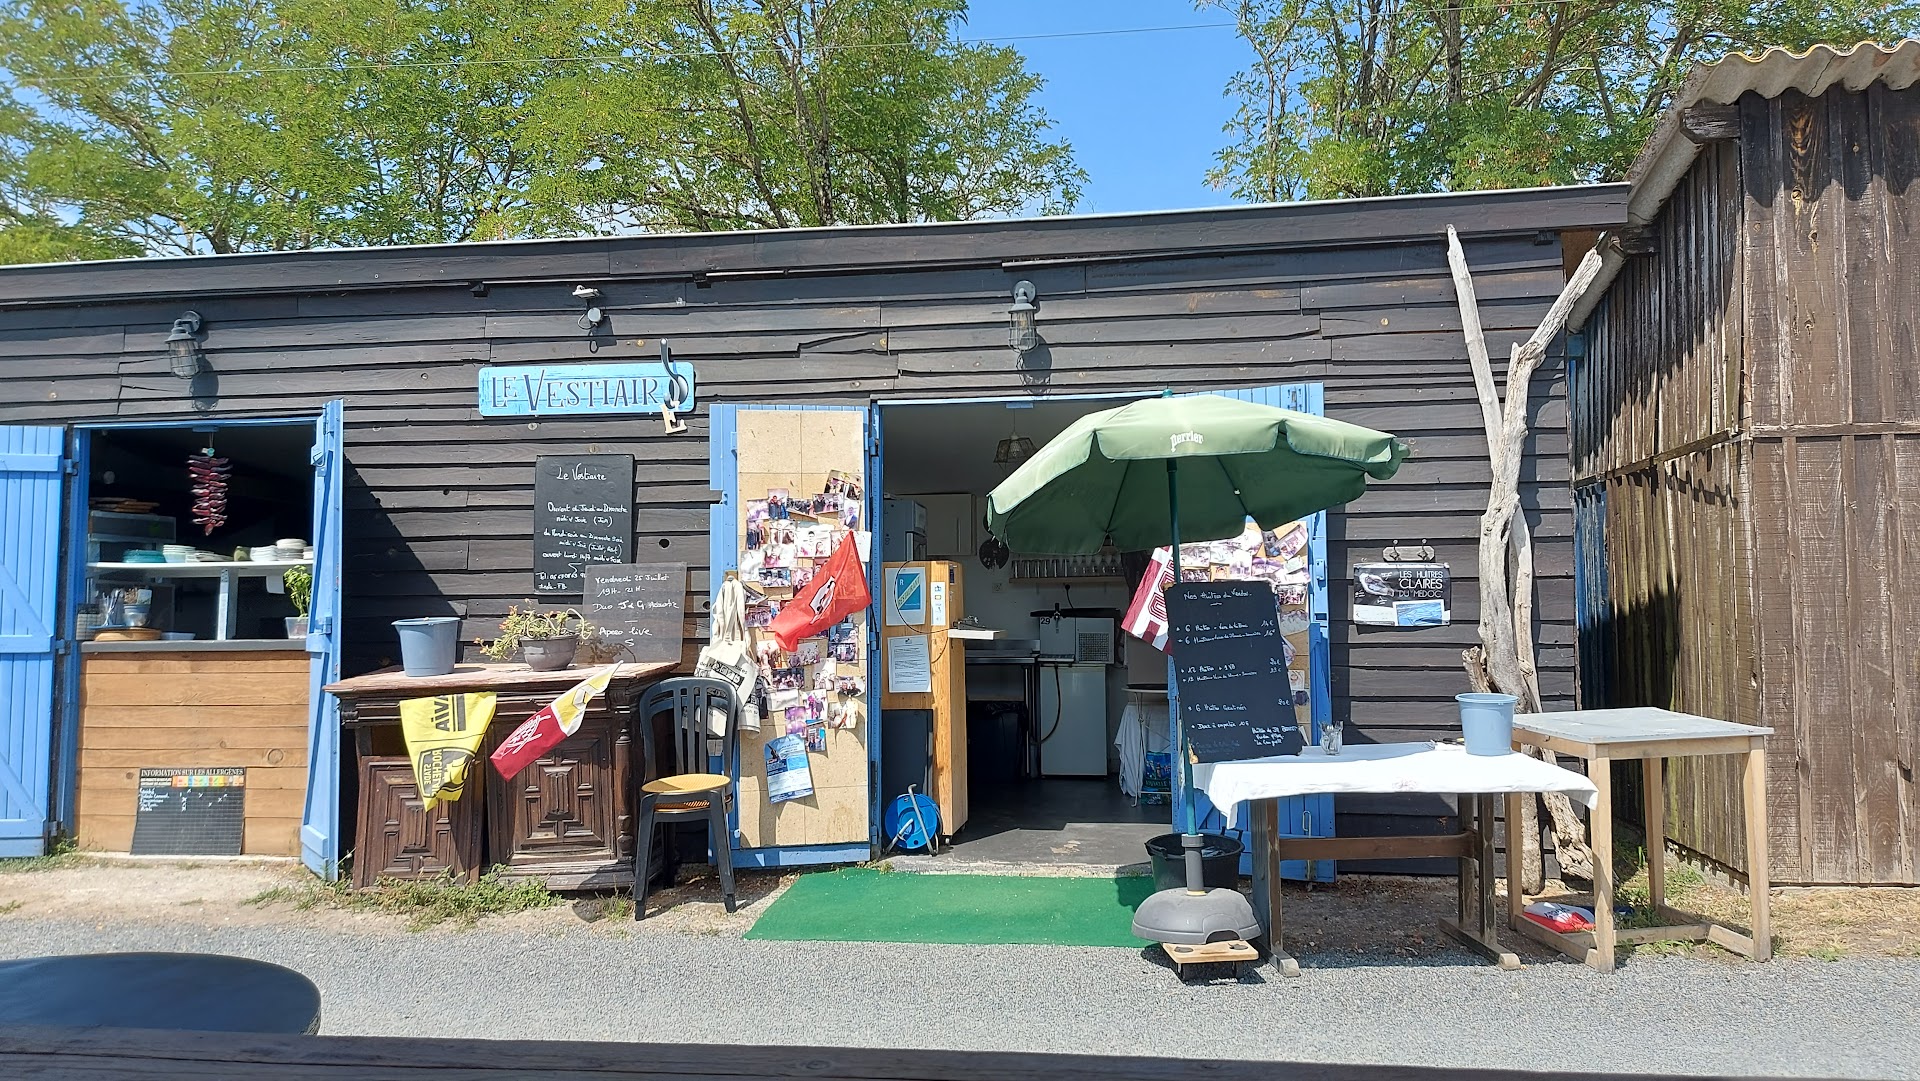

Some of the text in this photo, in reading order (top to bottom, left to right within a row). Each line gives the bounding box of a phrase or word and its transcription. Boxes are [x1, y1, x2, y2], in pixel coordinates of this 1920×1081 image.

[491, 376, 517, 408] LE
[556, 466, 570, 480] Le
[1399, 570, 1413, 579] LES
[1399, 578, 1443, 589] CLAIRES
[1398, 590, 1410, 598] DU
[141, 769, 181, 777] INFORMATION
